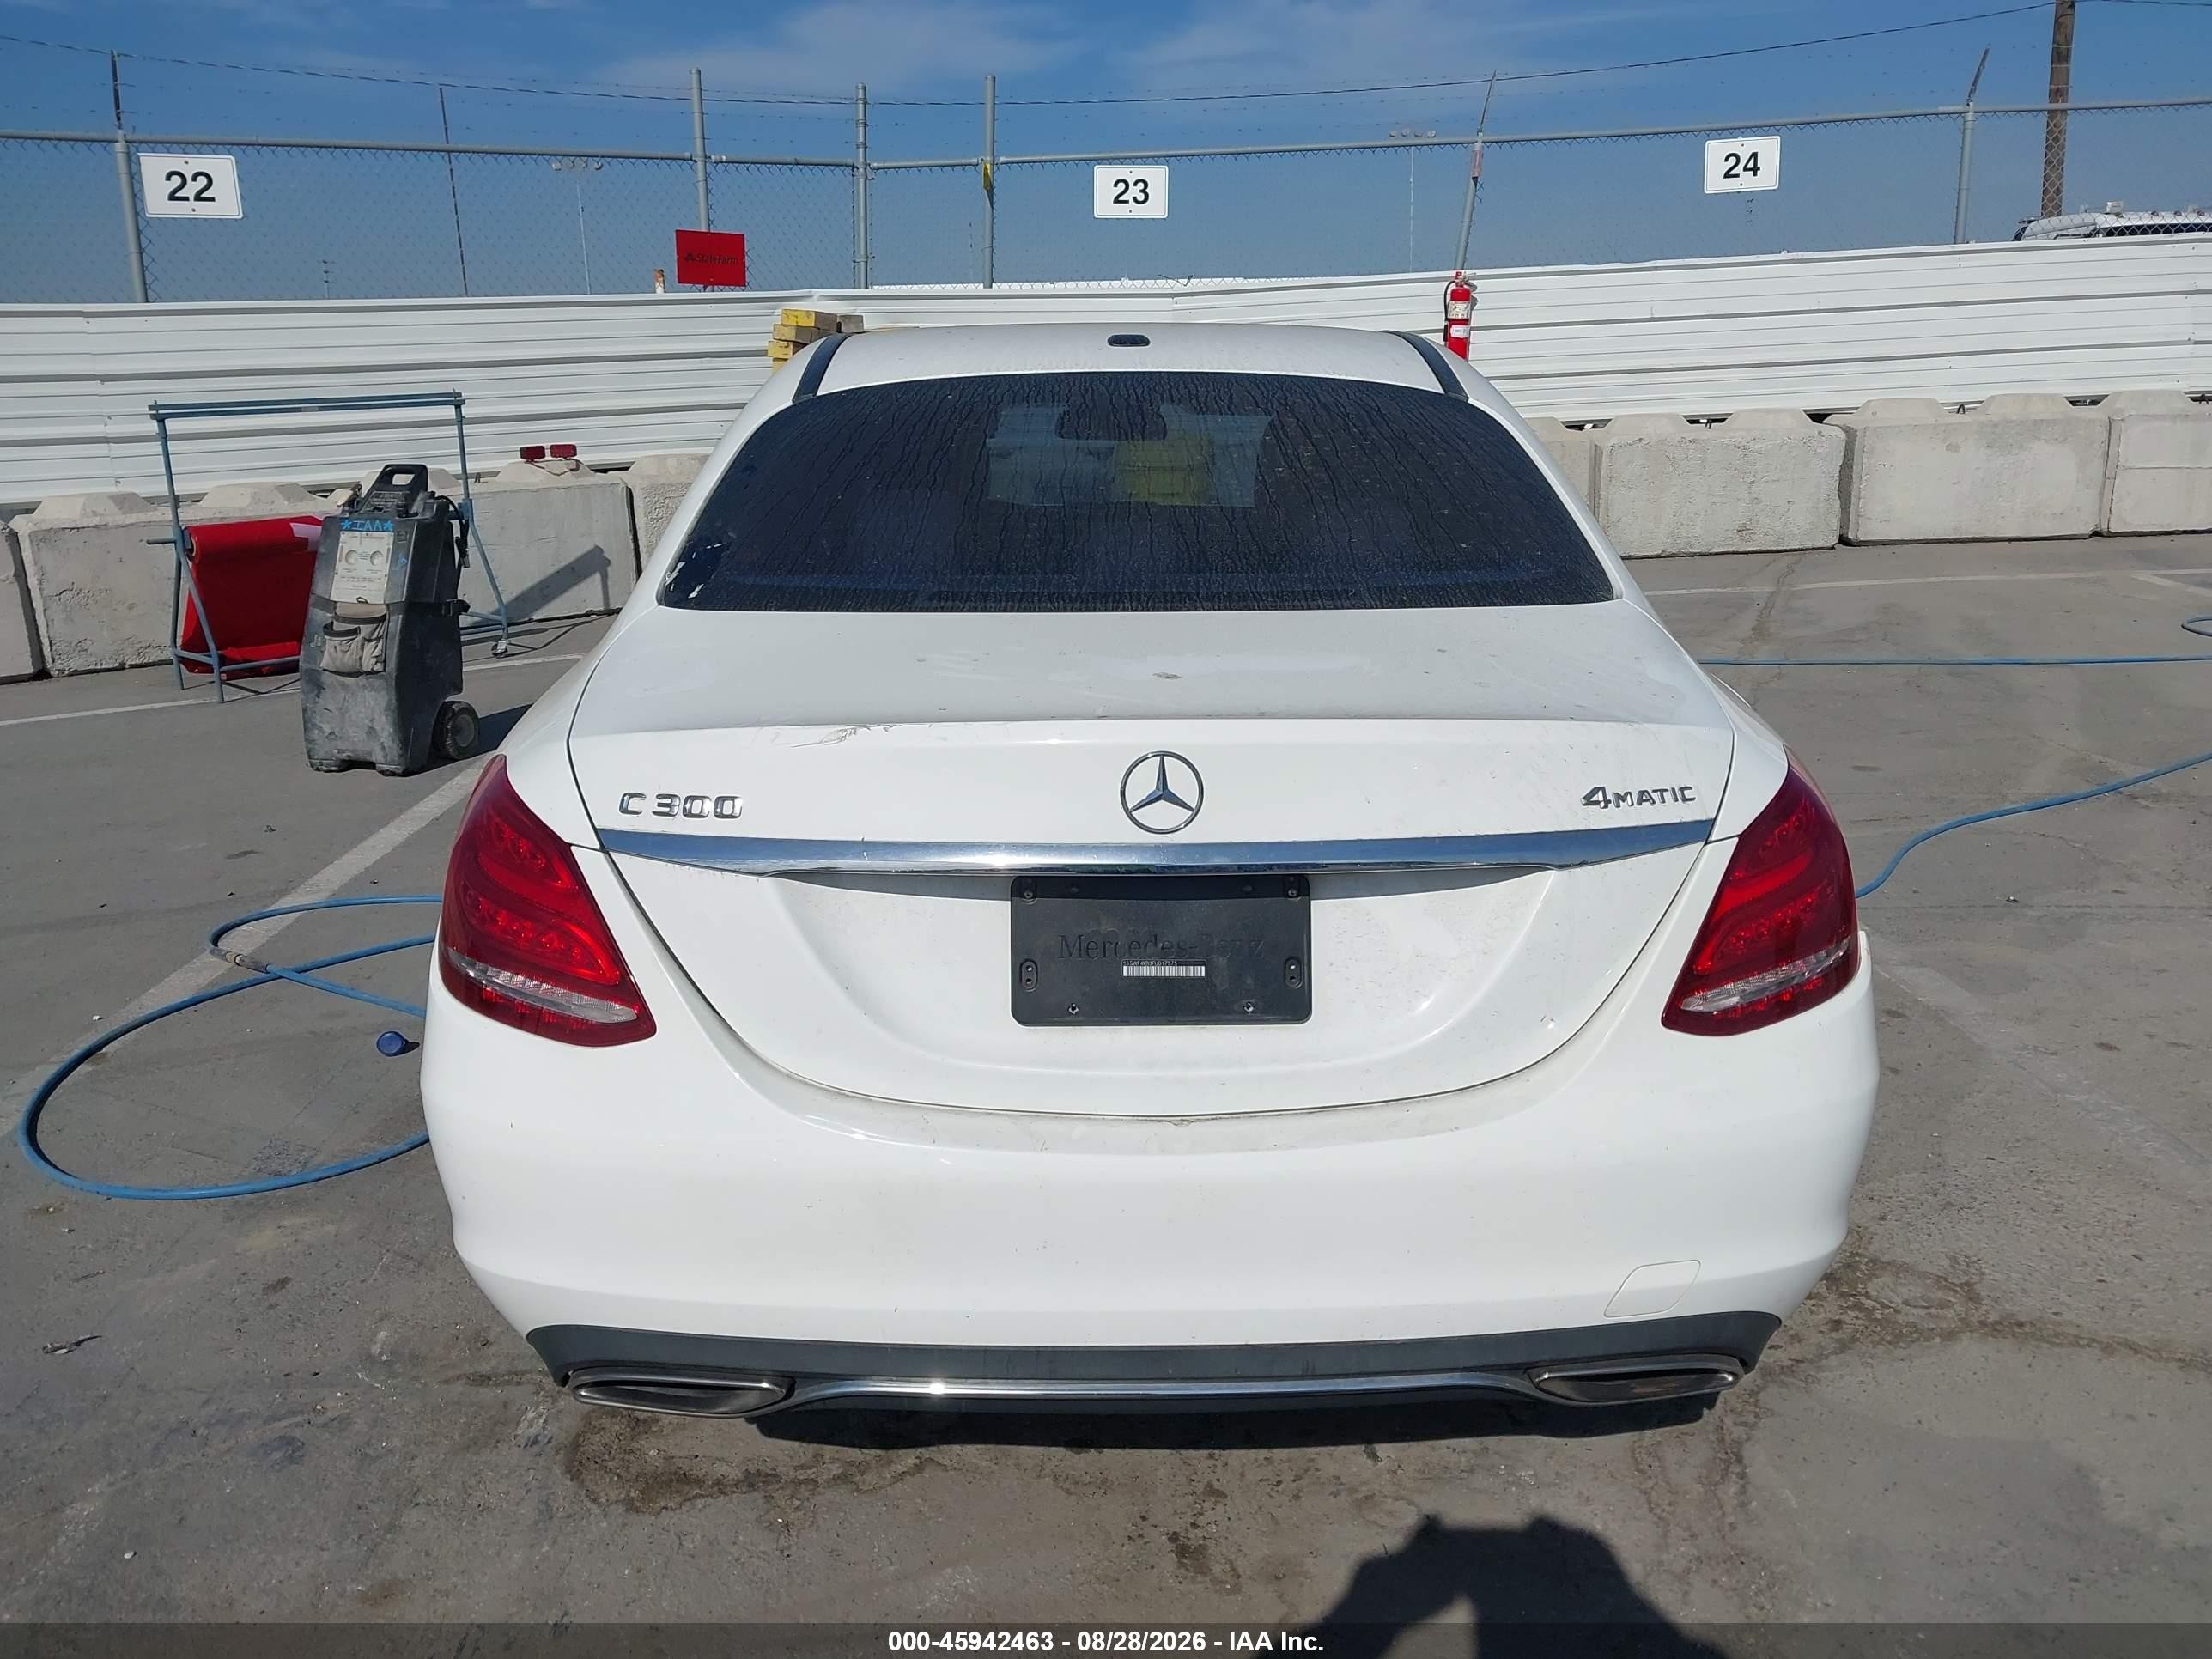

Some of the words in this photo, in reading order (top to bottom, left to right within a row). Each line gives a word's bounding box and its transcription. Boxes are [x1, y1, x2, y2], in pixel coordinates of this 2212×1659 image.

[1723, 151, 1761, 179] 24
[165, 170, 216, 202] 22
[1113, 179, 1149, 204] 23
[619, 792, 646, 815] C
[652, 793, 743, 818] 300
[1581, 786, 1696, 809] 4MATIC
